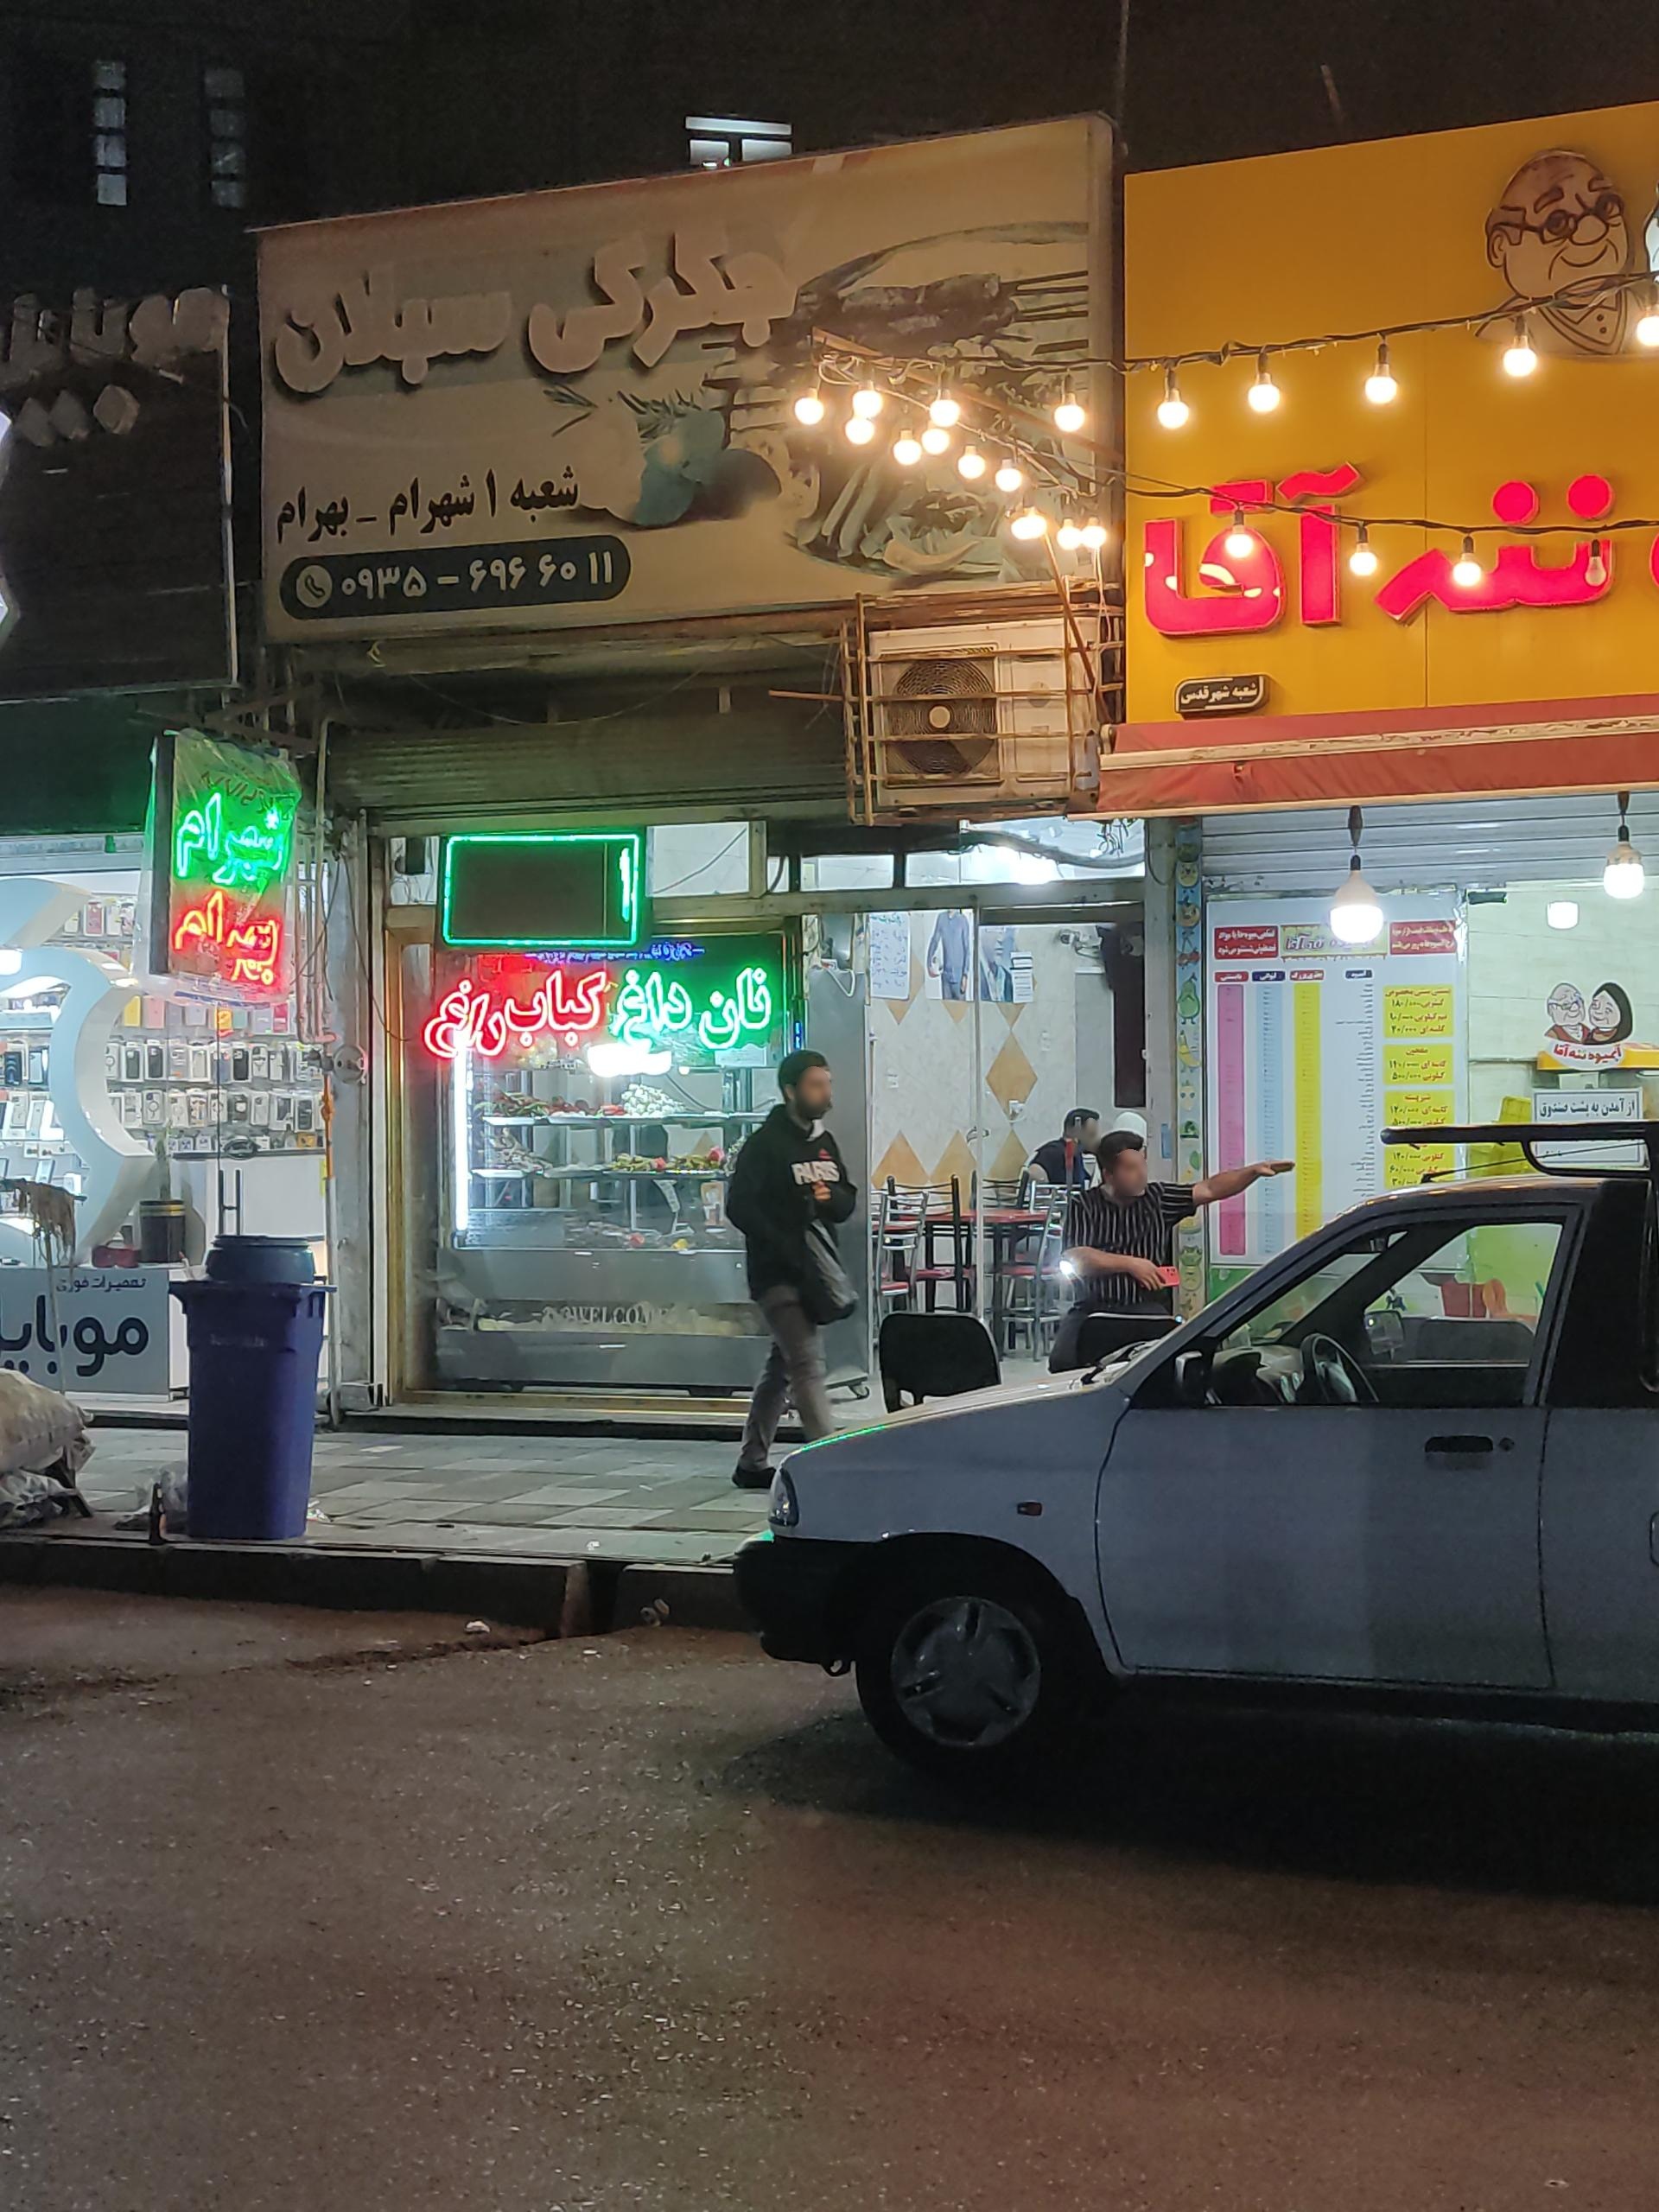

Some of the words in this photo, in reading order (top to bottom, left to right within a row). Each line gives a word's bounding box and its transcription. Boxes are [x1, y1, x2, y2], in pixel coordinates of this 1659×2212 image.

[276, 263, 513, 393] سبلان
[276, 486, 350, 544] بهرام
[389, 474, 476, 535] شهرام
[510, 465, 580, 523] شعبه
[340, 564, 428, 601] ۰۹۳۵
[468, 554, 526, 594] ۶۹۶
[538, 554, 576, 584] ۶۰
[588, 550, 613, 584] ۱۱
[1143, 461, 1363, 636] آقا
[1374, 474, 1615, 626] ننه
[1208, 684, 1231, 703] شهر
[1232, 682, 1258, 702] شعبه
[423, 979, 508, 1059] داغ
[504, 969, 608, 1049] کباب
[608, 968, 694, 1052] داغ
[697, 967, 773, 1052] نان
[1569, 1100, 1590, 1117] پشت
[1591, 1101, 1600, 1117] به
[1600, 1096, 1625, 1117] آمدن
[1625, 1100, 1636, 1117] از
